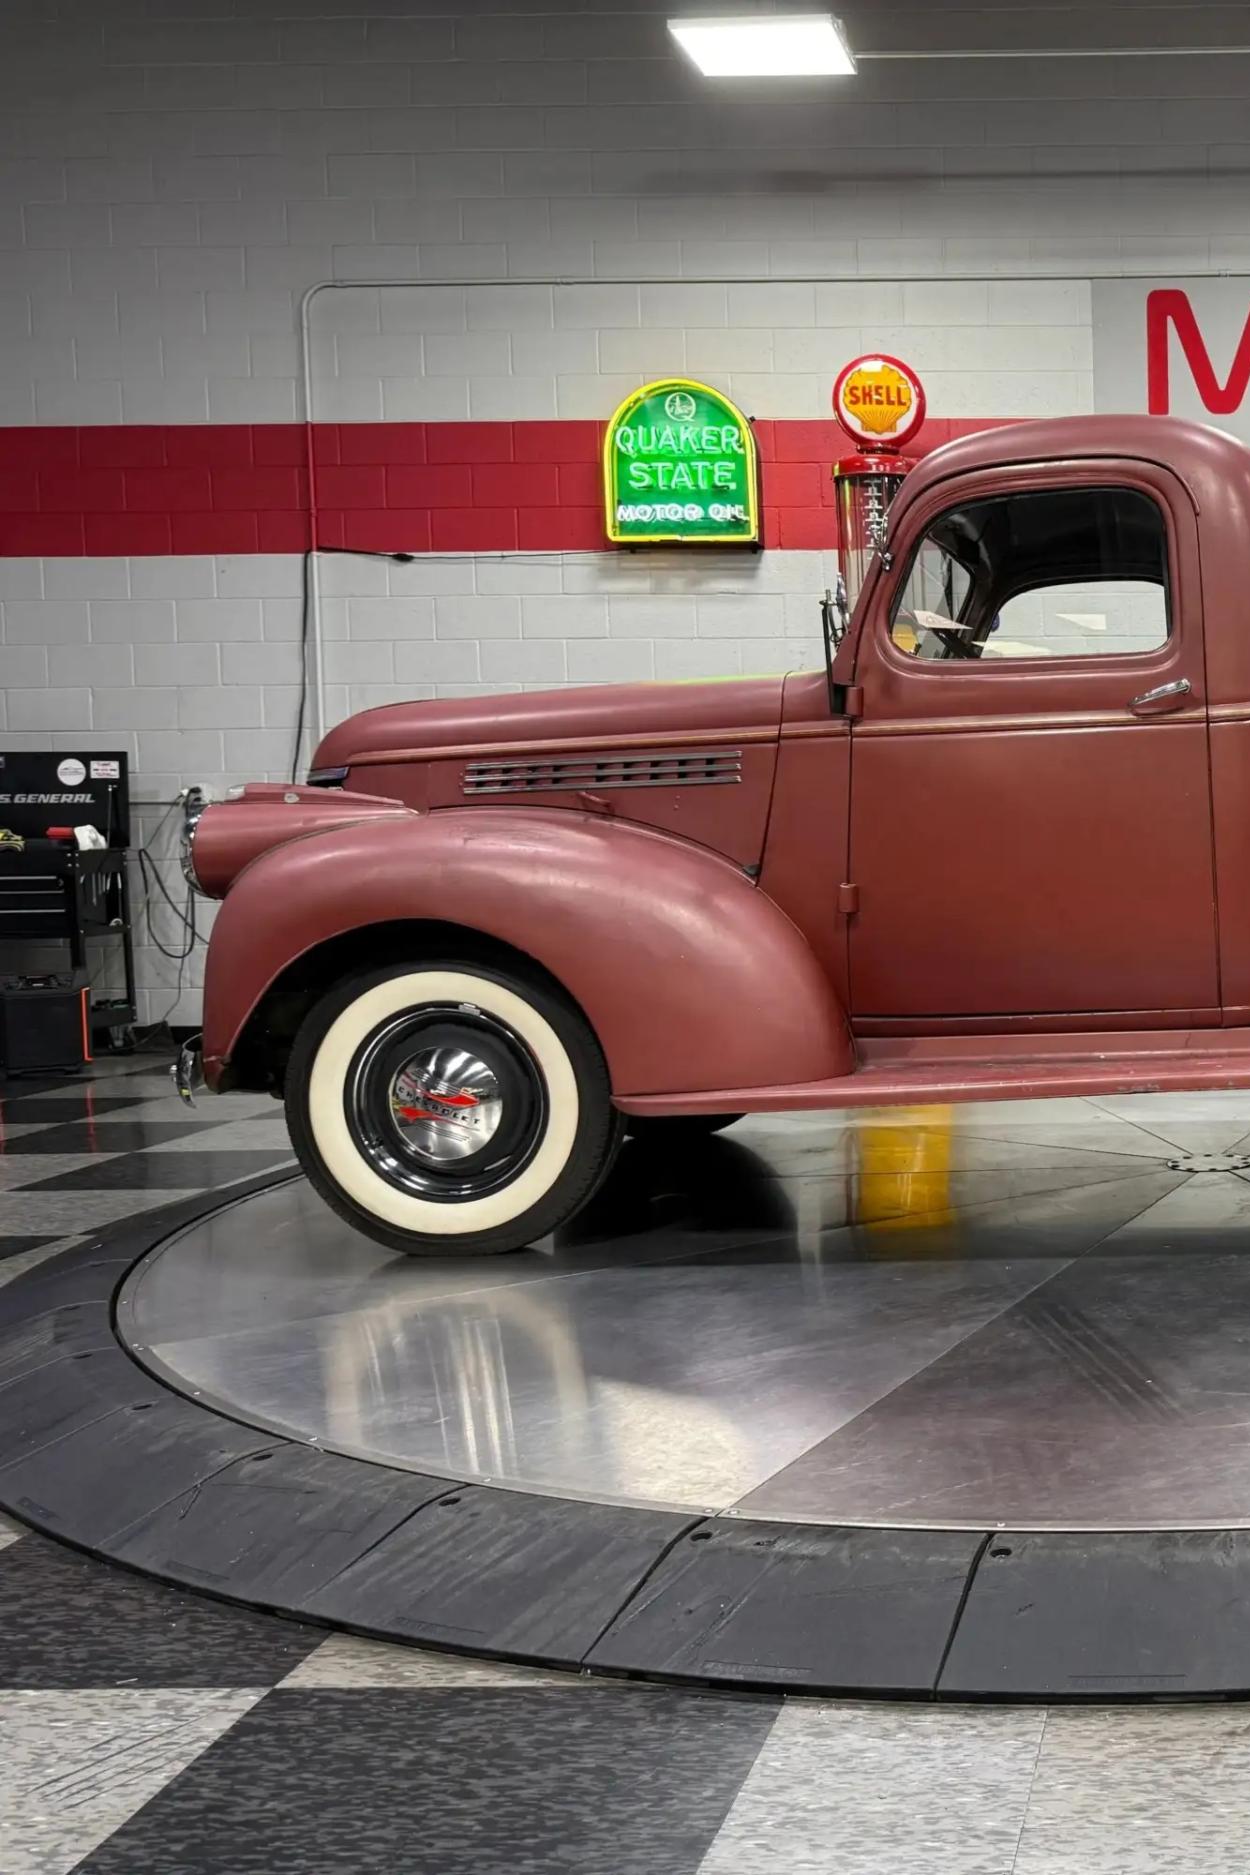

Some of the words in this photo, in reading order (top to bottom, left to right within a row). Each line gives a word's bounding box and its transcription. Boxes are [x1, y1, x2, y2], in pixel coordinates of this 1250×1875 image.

[848, 384, 907, 407] SHELL
[615, 425, 745, 458] QUAKER
[628, 461, 737, 490] STATE
[617, 503, 705, 522] MOTOR
[708, 503, 749, 522] OIL
[13, 793, 96, 804] GENERAL
